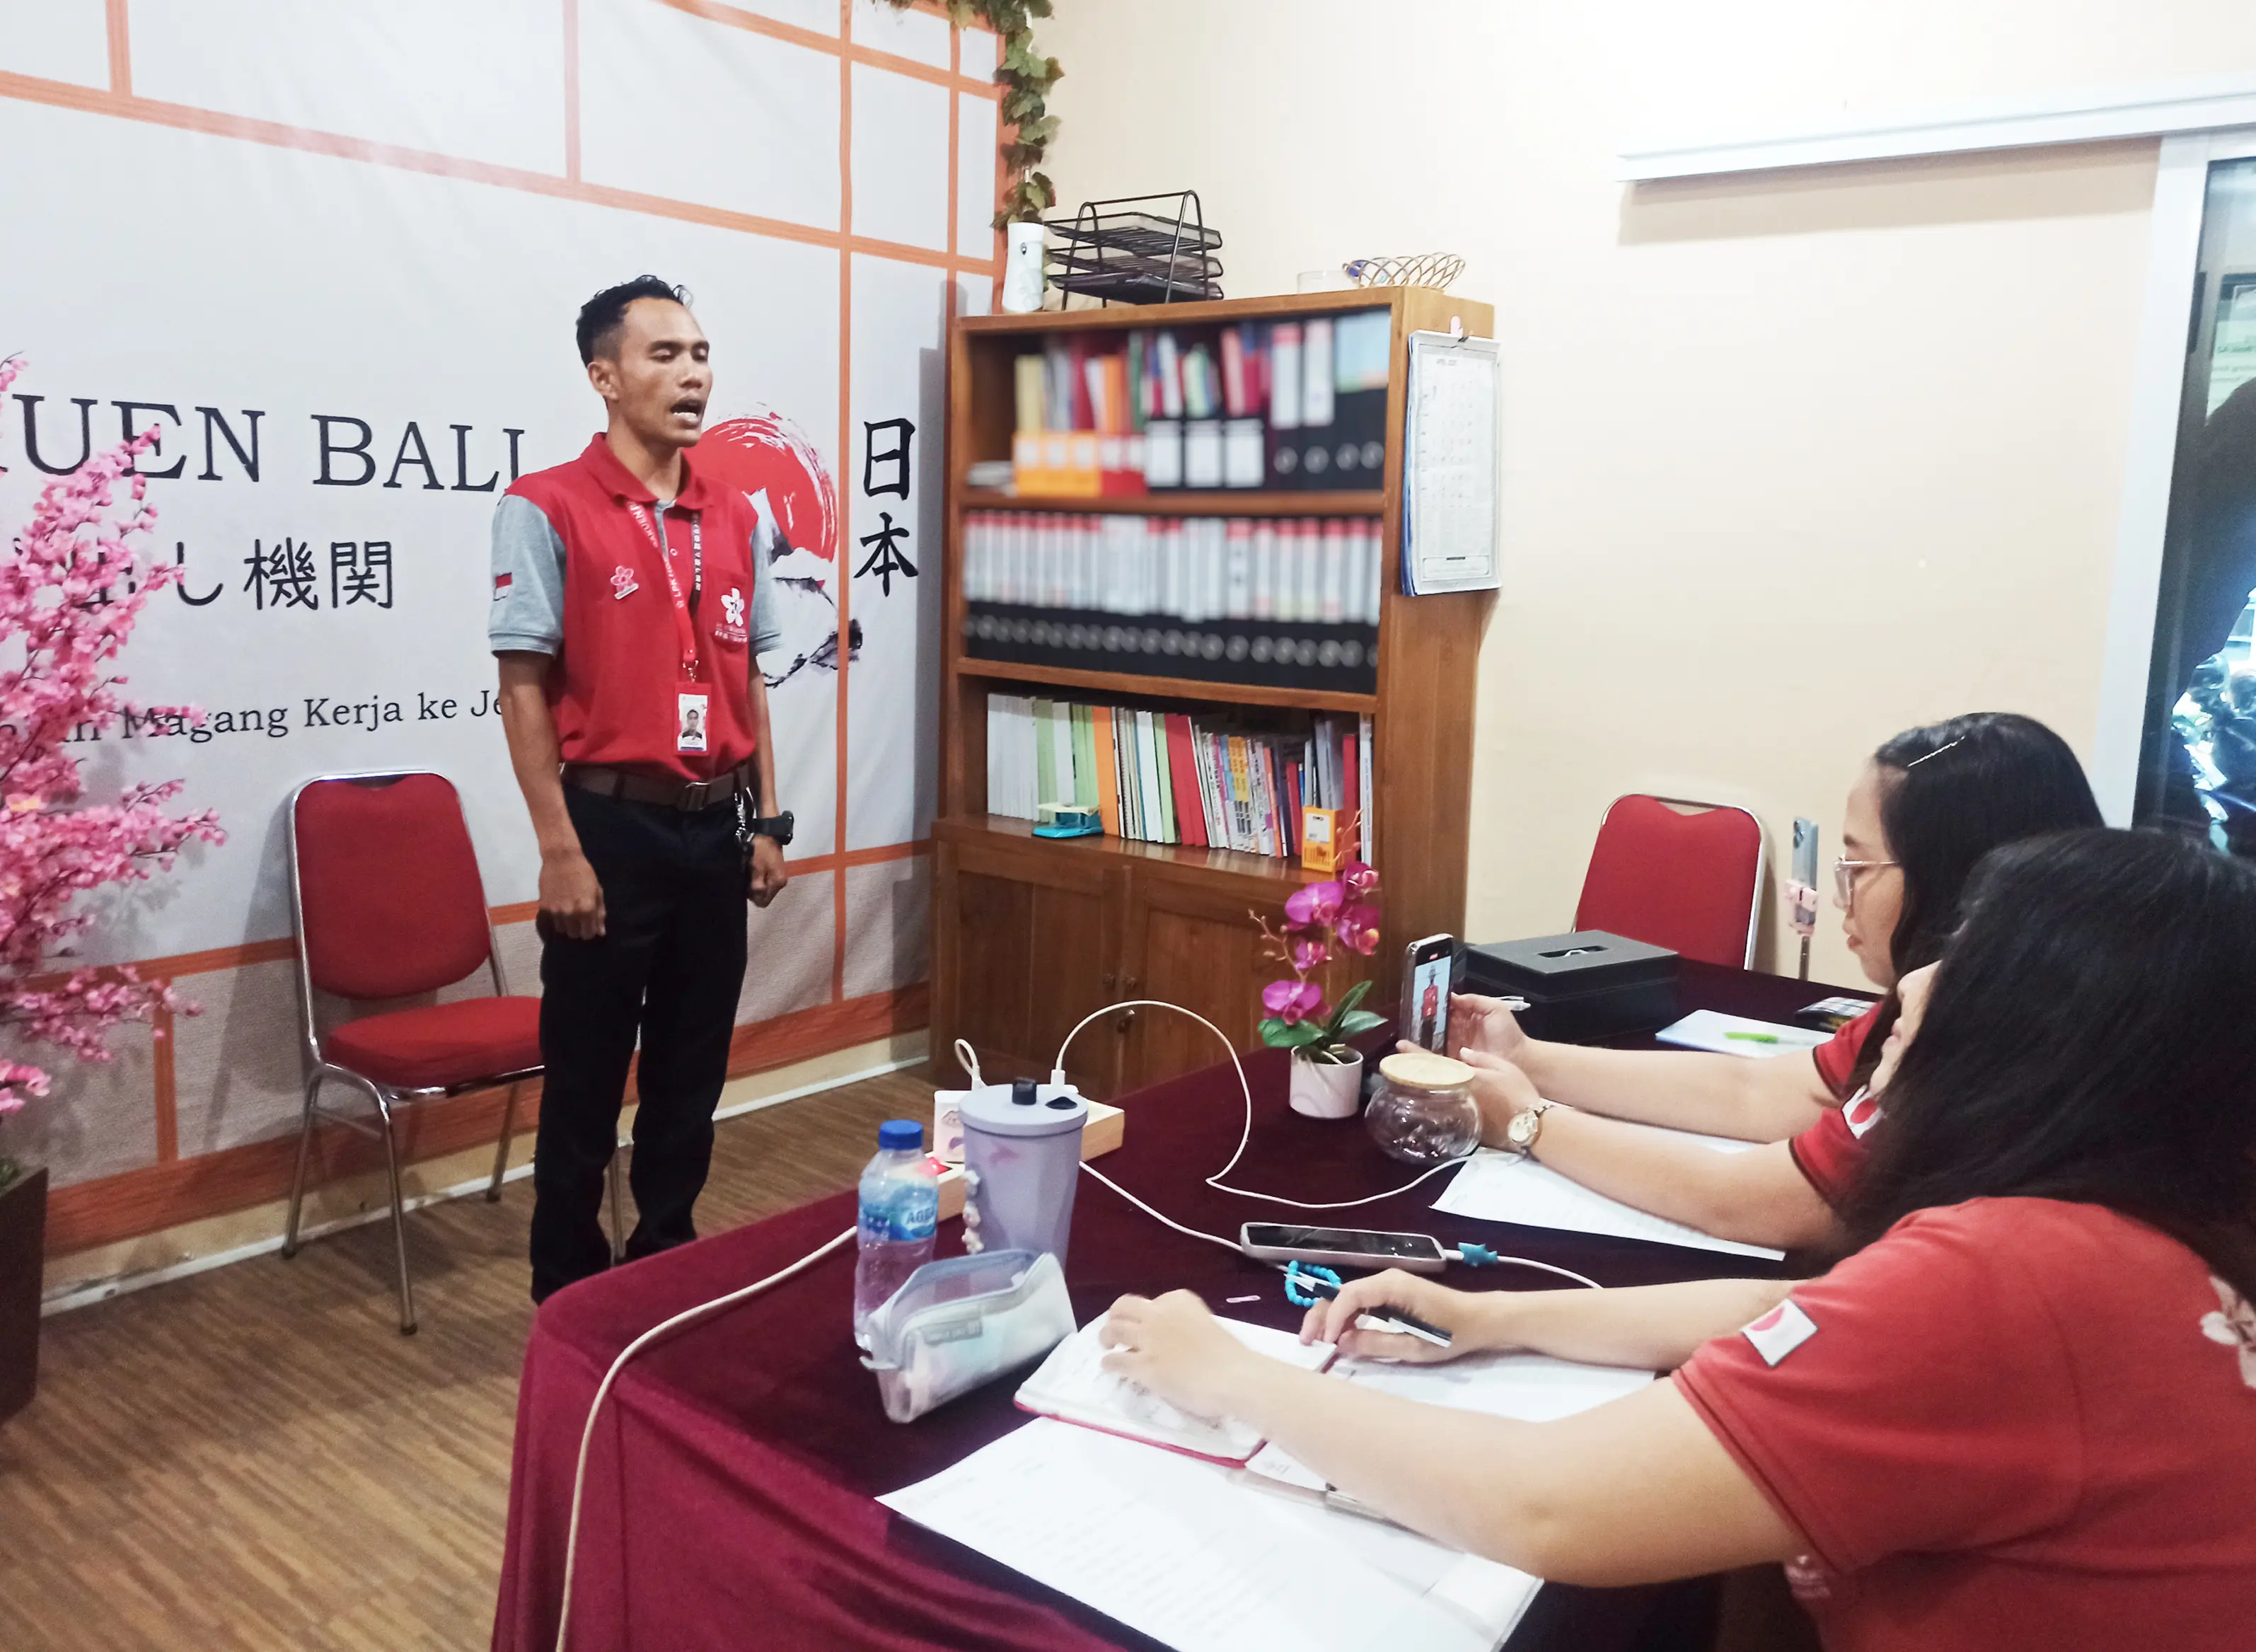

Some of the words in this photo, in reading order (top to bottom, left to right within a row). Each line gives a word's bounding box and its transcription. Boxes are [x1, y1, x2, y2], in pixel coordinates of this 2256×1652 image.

[0, 394, 265, 483] UEN
[311, 414, 525, 492] BALI
[853, 417, 919, 597] 日本
[122, 705, 289, 744] Magang
[303, 695, 403, 732] Kerja
[417, 692, 457, 720] ke
